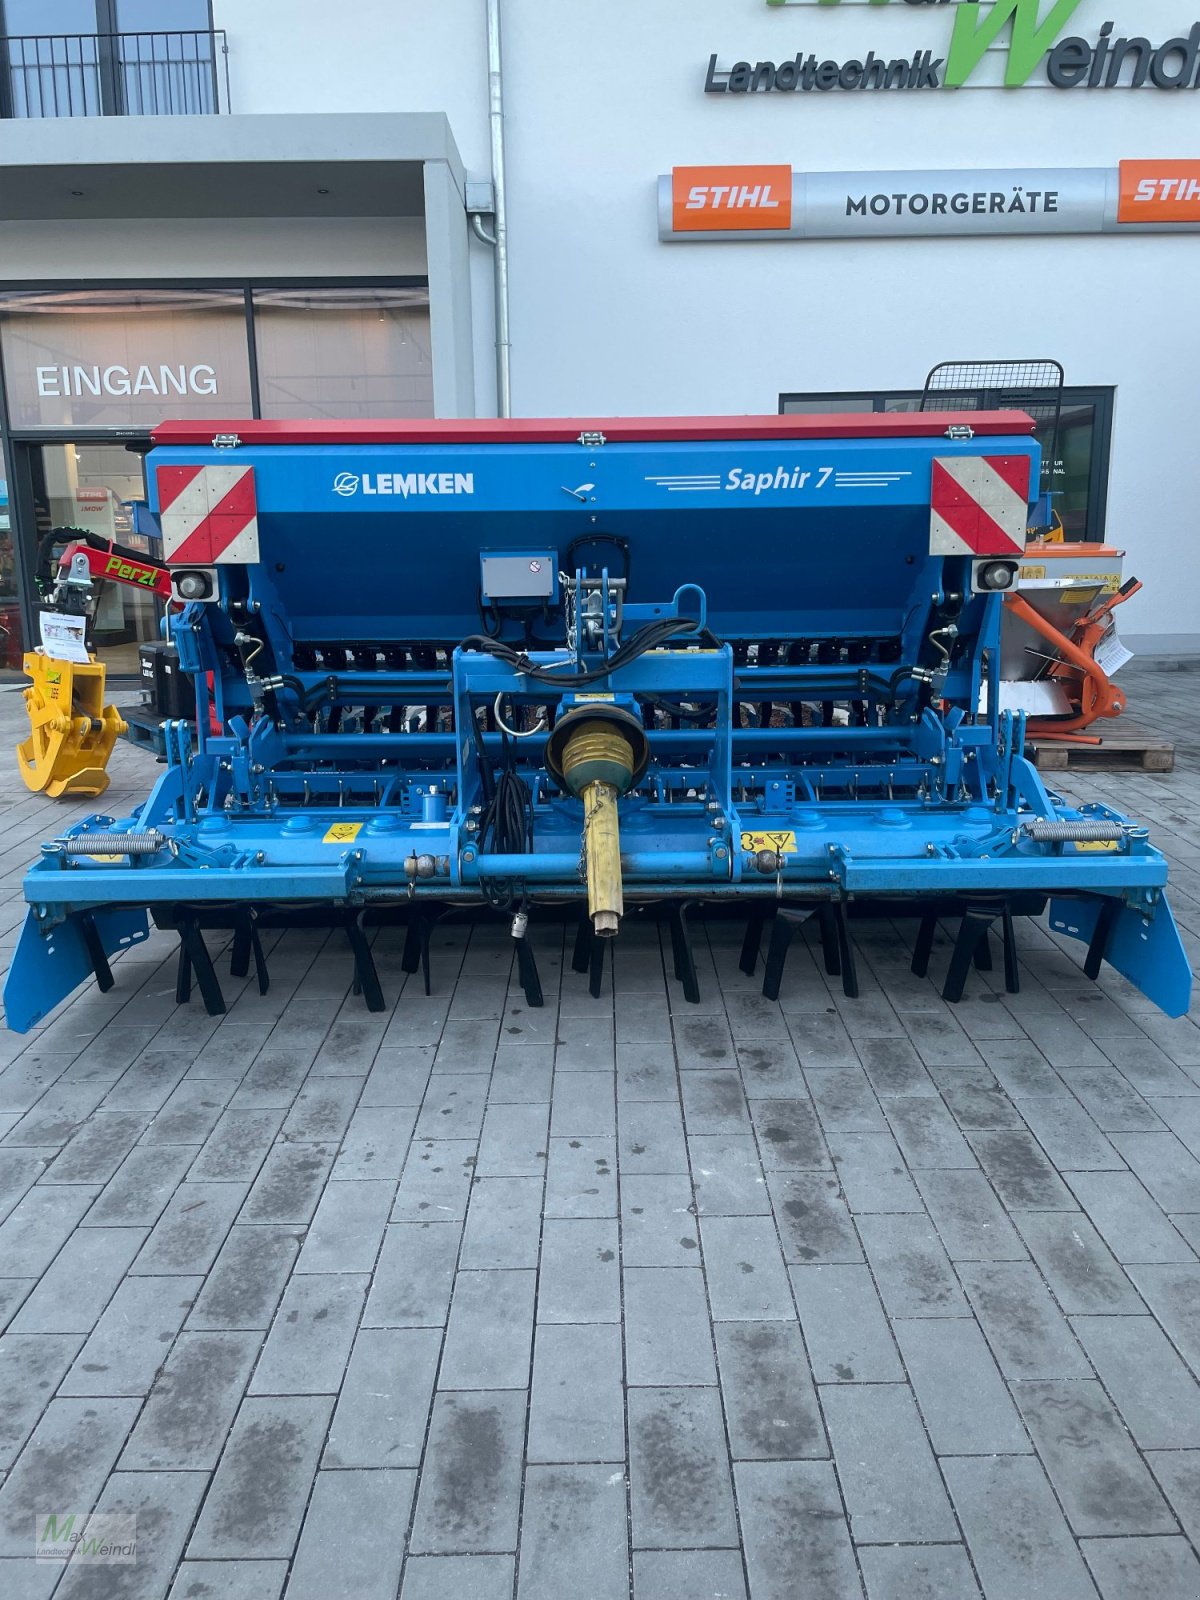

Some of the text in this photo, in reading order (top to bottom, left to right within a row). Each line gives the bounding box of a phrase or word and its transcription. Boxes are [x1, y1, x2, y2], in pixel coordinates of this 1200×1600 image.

[704, 0, 1200, 93] Landtechnik Weind
[685, 185, 779, 210] STIHL
[846, 187, 1058, 216] MOTORGERÄTE
[36, 364, 218, 397] EINGANG
[362, 472, 475, 499] LEMKEN
[724, 466, 834, 496] Saphir 7
[105, 557, 159, 587] Perzl
